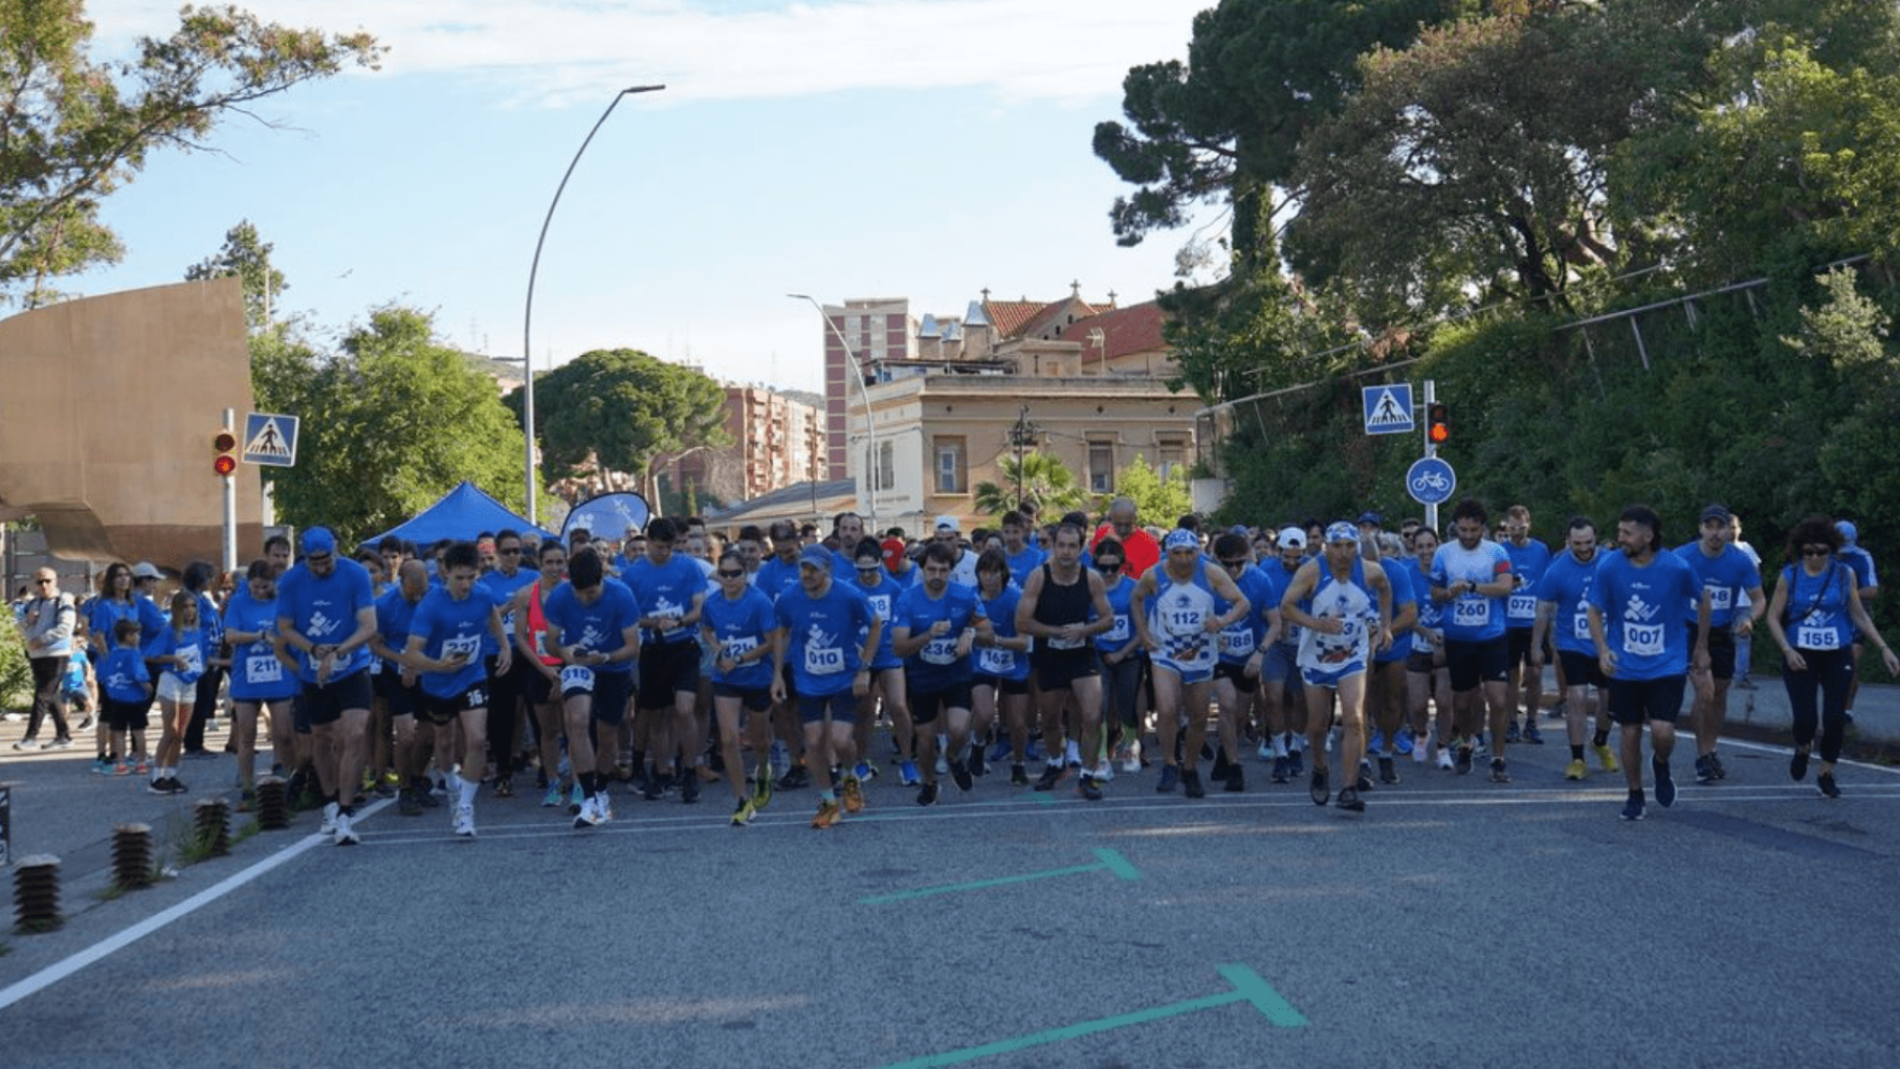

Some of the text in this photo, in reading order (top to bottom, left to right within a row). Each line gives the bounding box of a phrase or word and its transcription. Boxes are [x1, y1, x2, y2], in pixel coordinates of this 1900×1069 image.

[1456, 603, 1485, 616] 260
[1510, 599, 1533, 610] 072
[1172, 612, 1199, 624] 112
[1629, 628, 1661, 645] 007
[1803, 632, 1834, 646] 155
[808, 650, 838, 665] 010
[253, 659, 276, 673] 211
